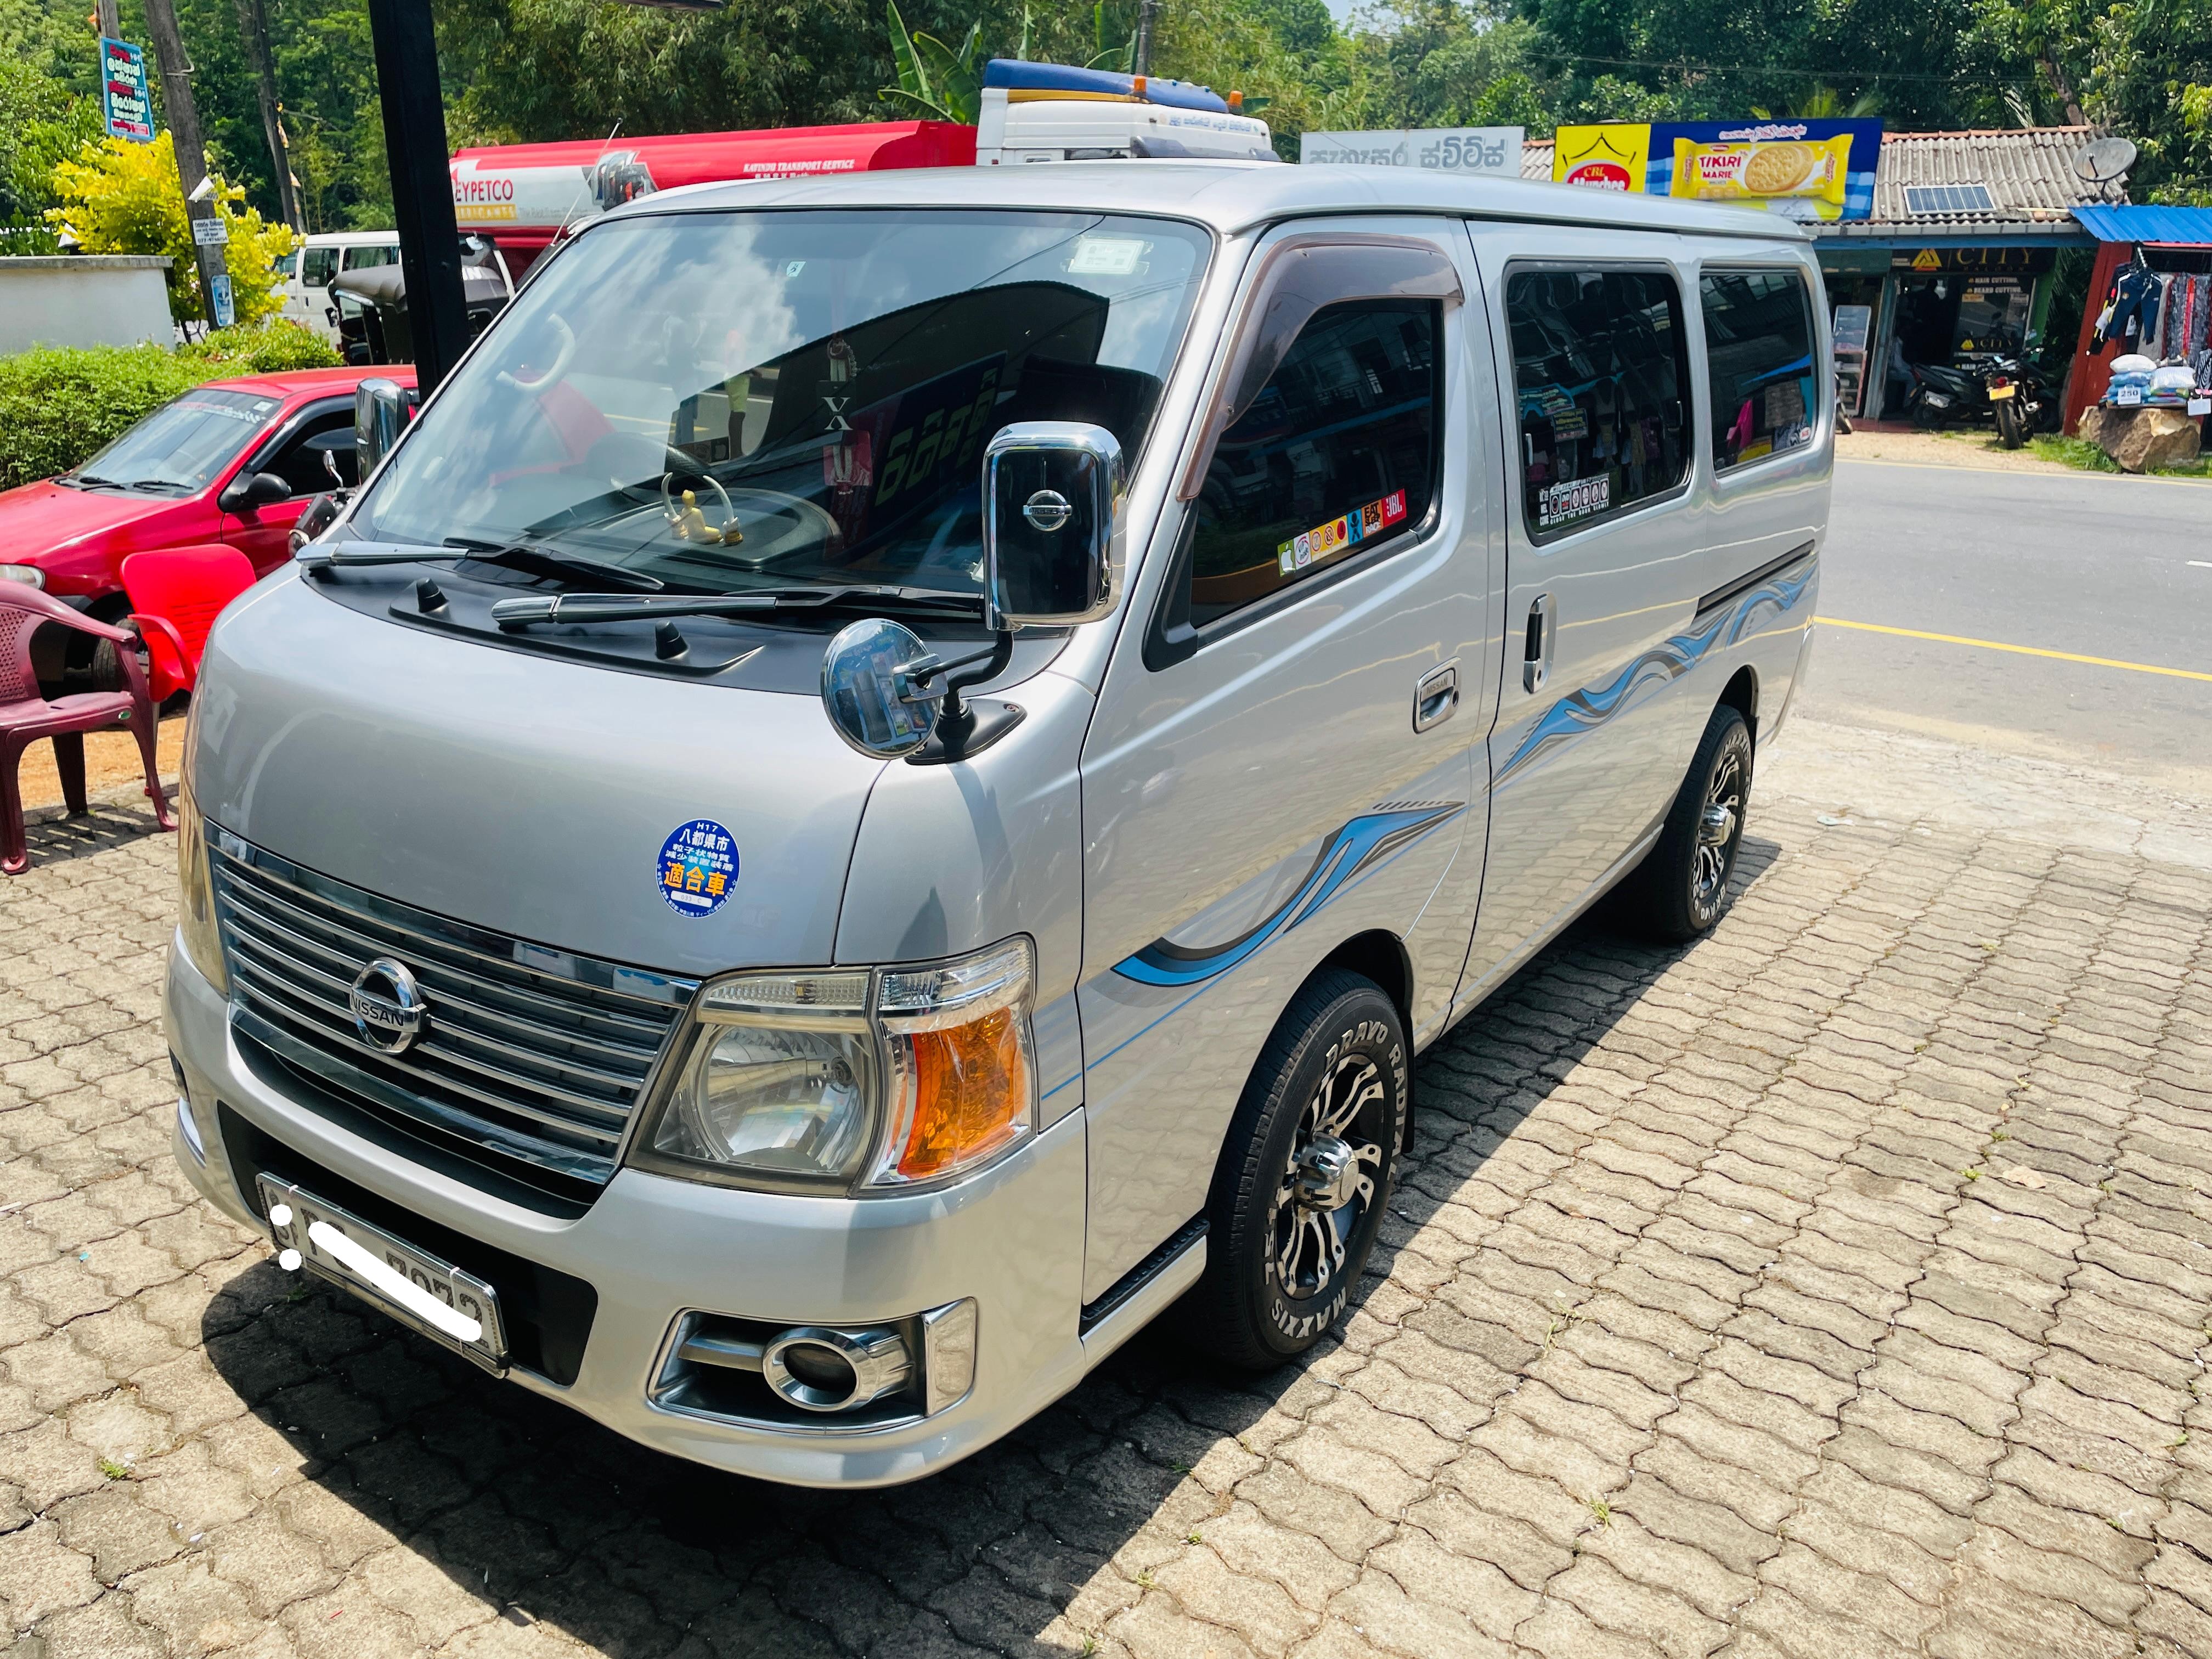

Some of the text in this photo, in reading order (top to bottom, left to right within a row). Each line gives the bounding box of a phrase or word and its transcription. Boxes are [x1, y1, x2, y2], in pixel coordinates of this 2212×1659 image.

[777, 161, 822, 171] TRANSPORT
[822, 159, 855, 169] SERVICE
[1699, 156, 1741, 168] TIKIRI
[1584, 166, 1605, 177] CBL
[1703, 171, 1733, 179] MARIE
[2121, 389, 2138, 398] 250
[1364, 502, 1379, 517] EAT
[1386, 493, 1402, 517] JBL
[1426, 676, 1448, 694] NISSAN
[696, 822, 718, 832] H17
[679, 828, 730, 851] 八都県市
[664, 860, 727, 897] 適合車
[351, 994, 404, 1027] NISSAN
[1325, 1020, 1406, 1181] BRAVO RADIAL
[1271, 1286, 1346, 1339] MAXXIS
